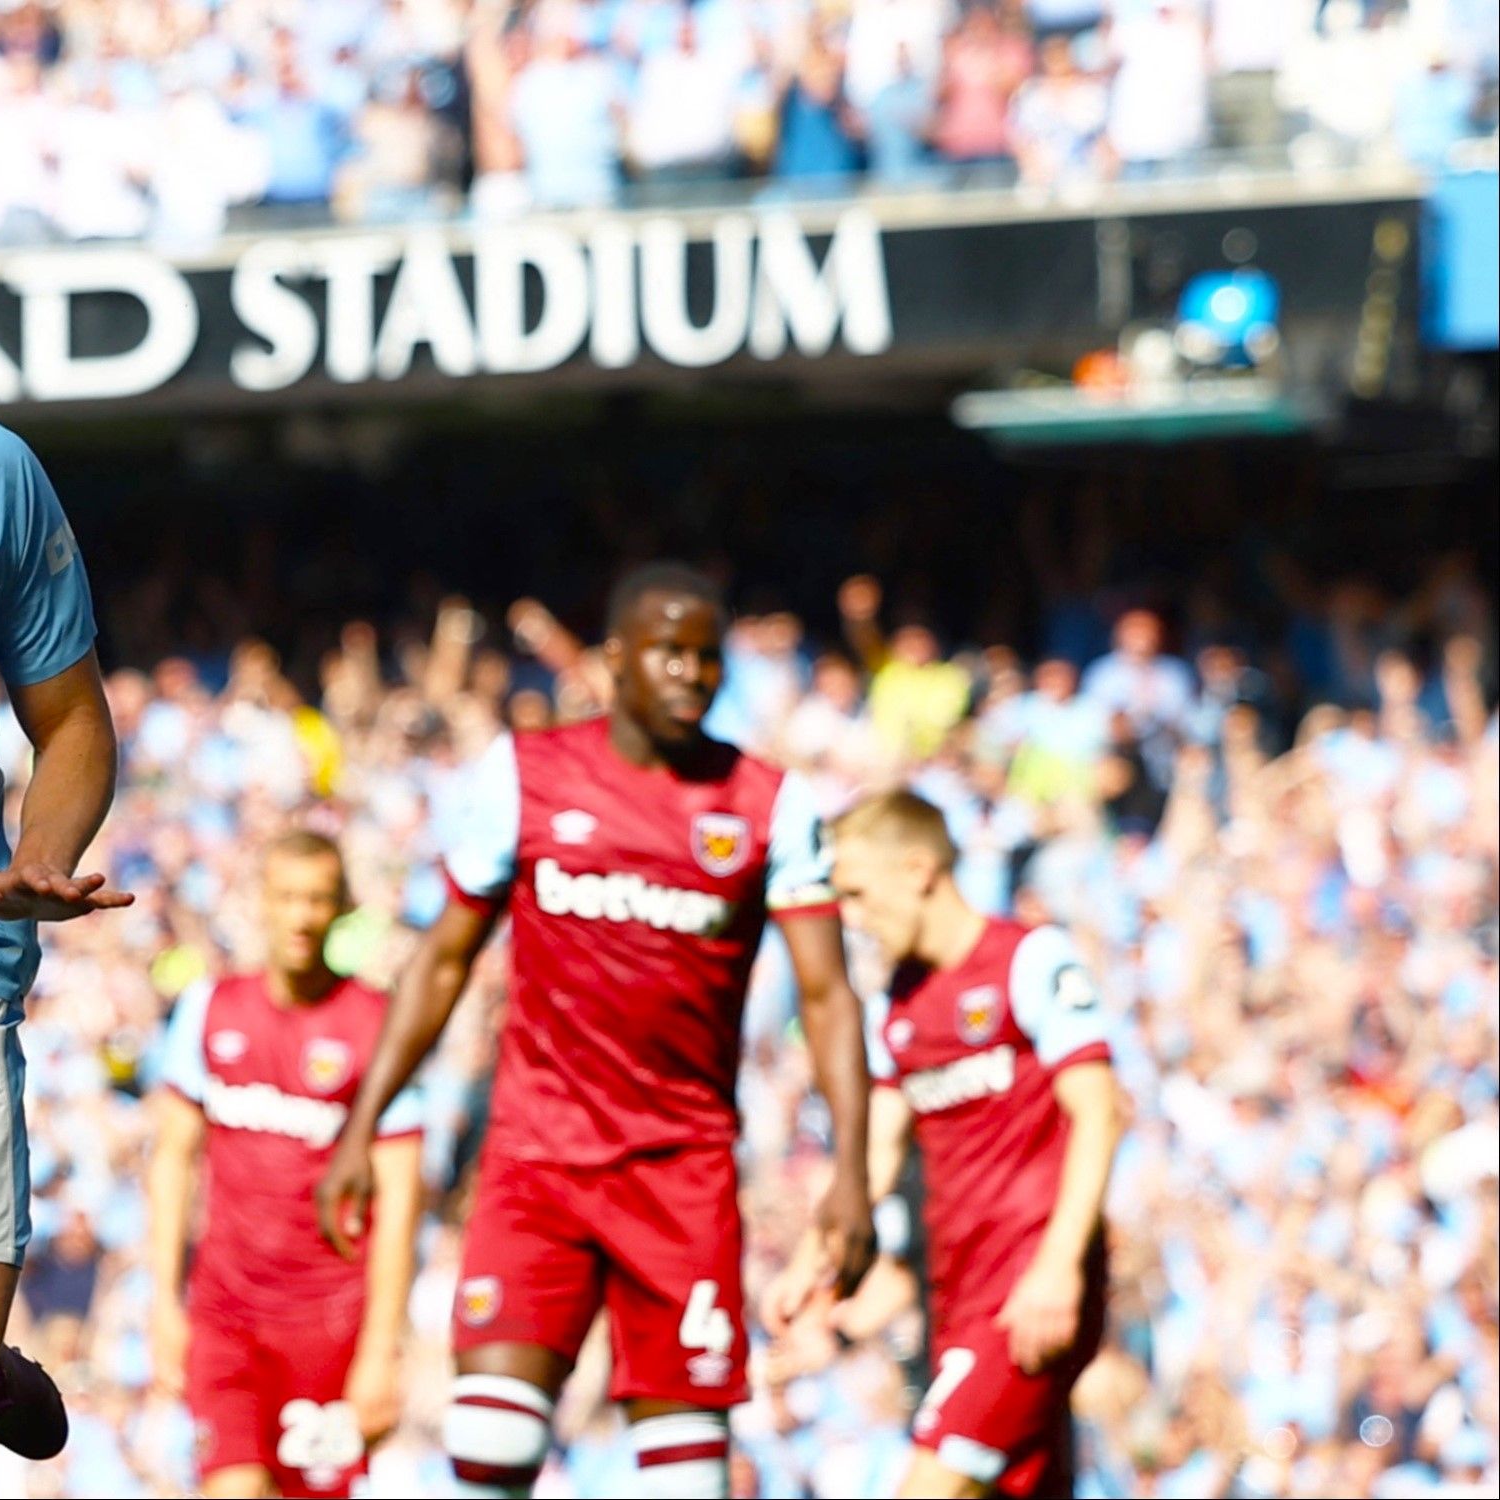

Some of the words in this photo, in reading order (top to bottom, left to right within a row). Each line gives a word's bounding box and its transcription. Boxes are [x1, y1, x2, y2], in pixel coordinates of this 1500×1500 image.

[229, 210, 893, 391] STADIUM
[534, 857, 728, 935] betway
[678, 1279, 735, 1355] 4
